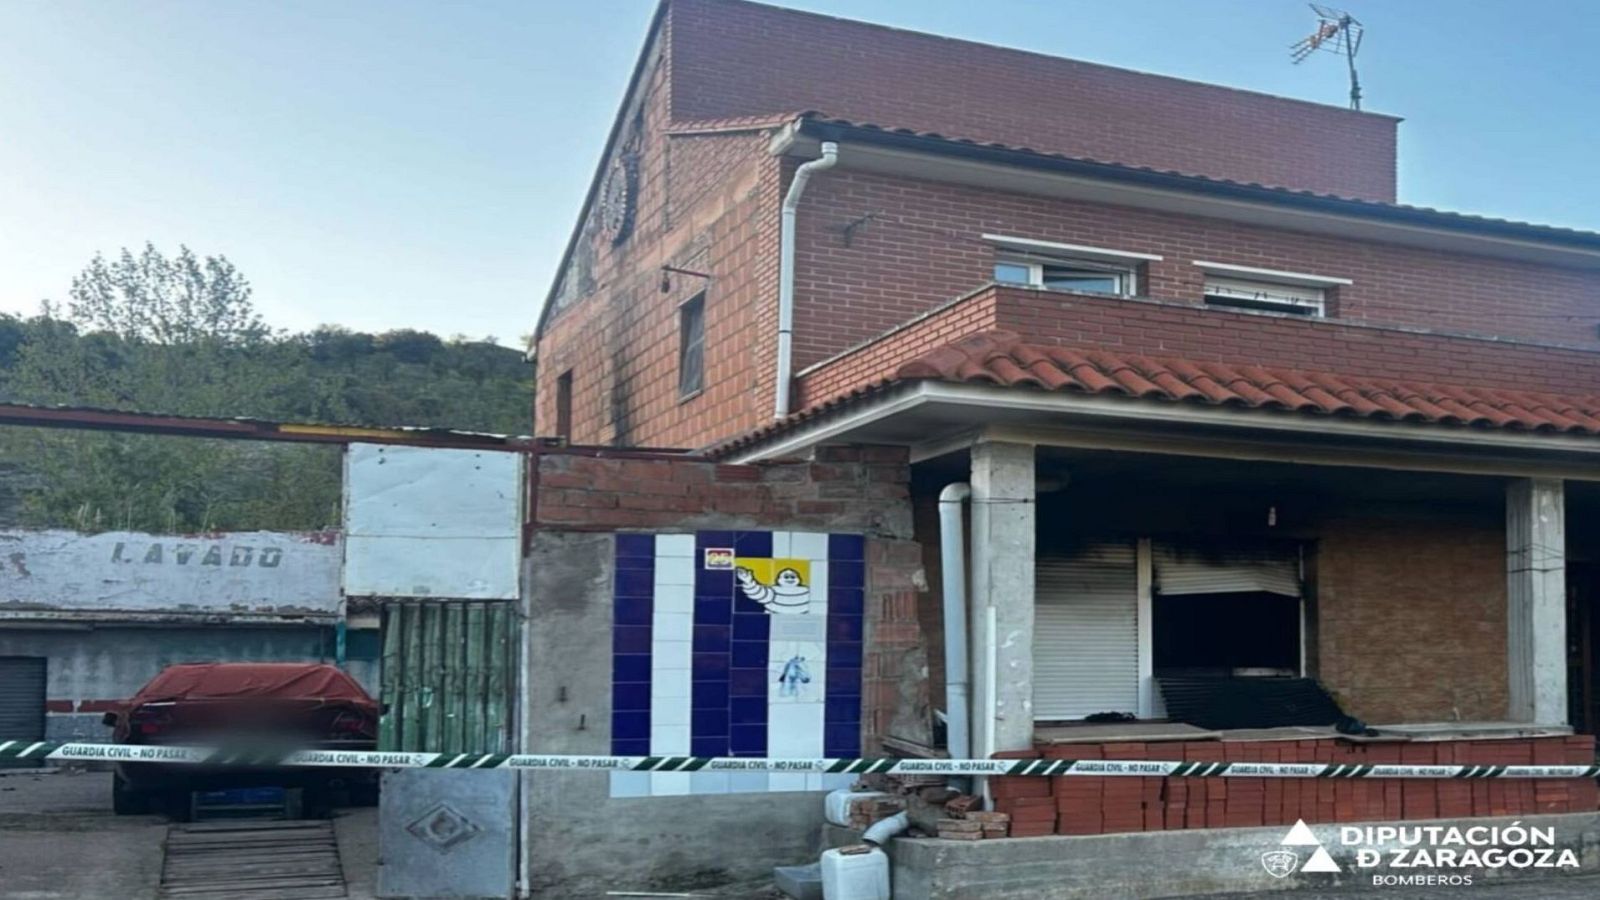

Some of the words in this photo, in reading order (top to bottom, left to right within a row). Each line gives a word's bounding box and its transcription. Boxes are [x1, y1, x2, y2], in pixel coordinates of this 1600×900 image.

[112, 542, 283, 568] LAVADO
[62, 746, 105, 757] GUARDIA
[107, 747, 131, 758] CIVIL
[140, 748, 155, 758] NO
[157, 749, 187, 759] PASAR
[336, 754, 358, 764] CIVIL
[367, 755, 381, 764] NO
[383, 755, 411, 765] PASAR
[509, 758, 547, 767] GUARDIA
[549, 759, 570, 768] CIVIL
[577, 759, 590, 768] NO
[591, 759, 619, 768] PASAR
[711, 760, 746, 769] GUARDIA
[748, 761, 767, 769] CIVIL
[774, 761, 787, 770] NO
[788, 761, 813, 770] PASAR
[899, 762, 933, 770] GUARDIA
[935, 762, 953, 771] CIVIL
[959, 762, 971, 771] NO
[971, 762, 995, 771] PASAR
[1076, 763, 1105, 771] GUARDIA
[1106, 763, 1122, 772] CIVIL
[1129, 764, 1138, 772] NO
[1139, 764, 1160, 772] PASAR
[1231, 765, 1258, 773] GUARDIA
[1259, 766, 1272, 774] CIVIL
[1280, 766, 1288, 774] NO
[1290, 766, 1309, 774] PASAR
